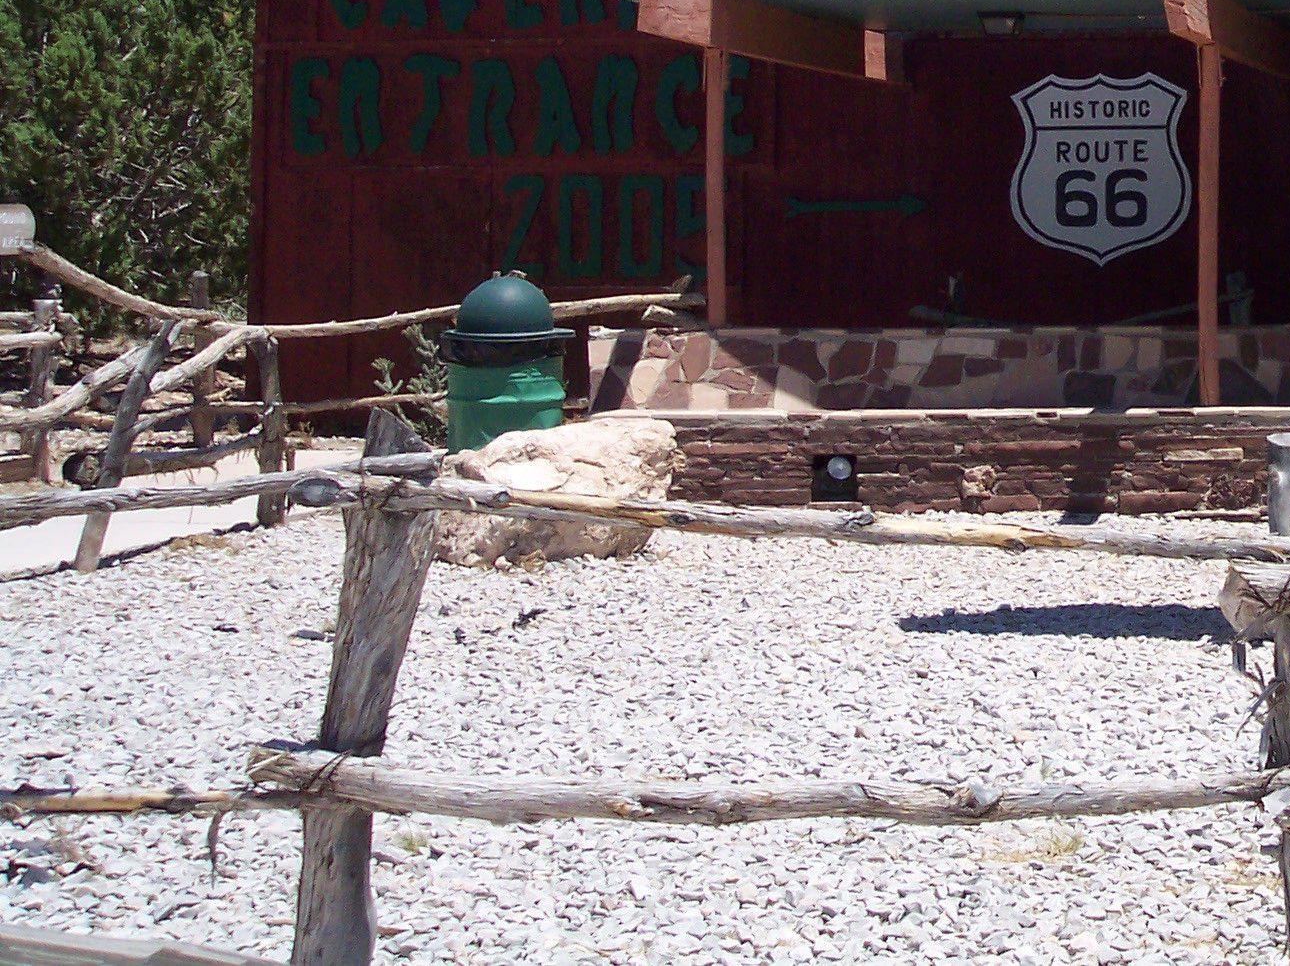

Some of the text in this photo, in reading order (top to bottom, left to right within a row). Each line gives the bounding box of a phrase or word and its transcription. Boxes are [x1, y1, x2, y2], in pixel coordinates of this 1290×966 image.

[290, 51, 756, 157] ENTRANCE
[1049, 99, 1152, 119] HISTORIC
[1055, 139, 1150, 164] ROUTE
[1054, 168, 1149, 228] 66
